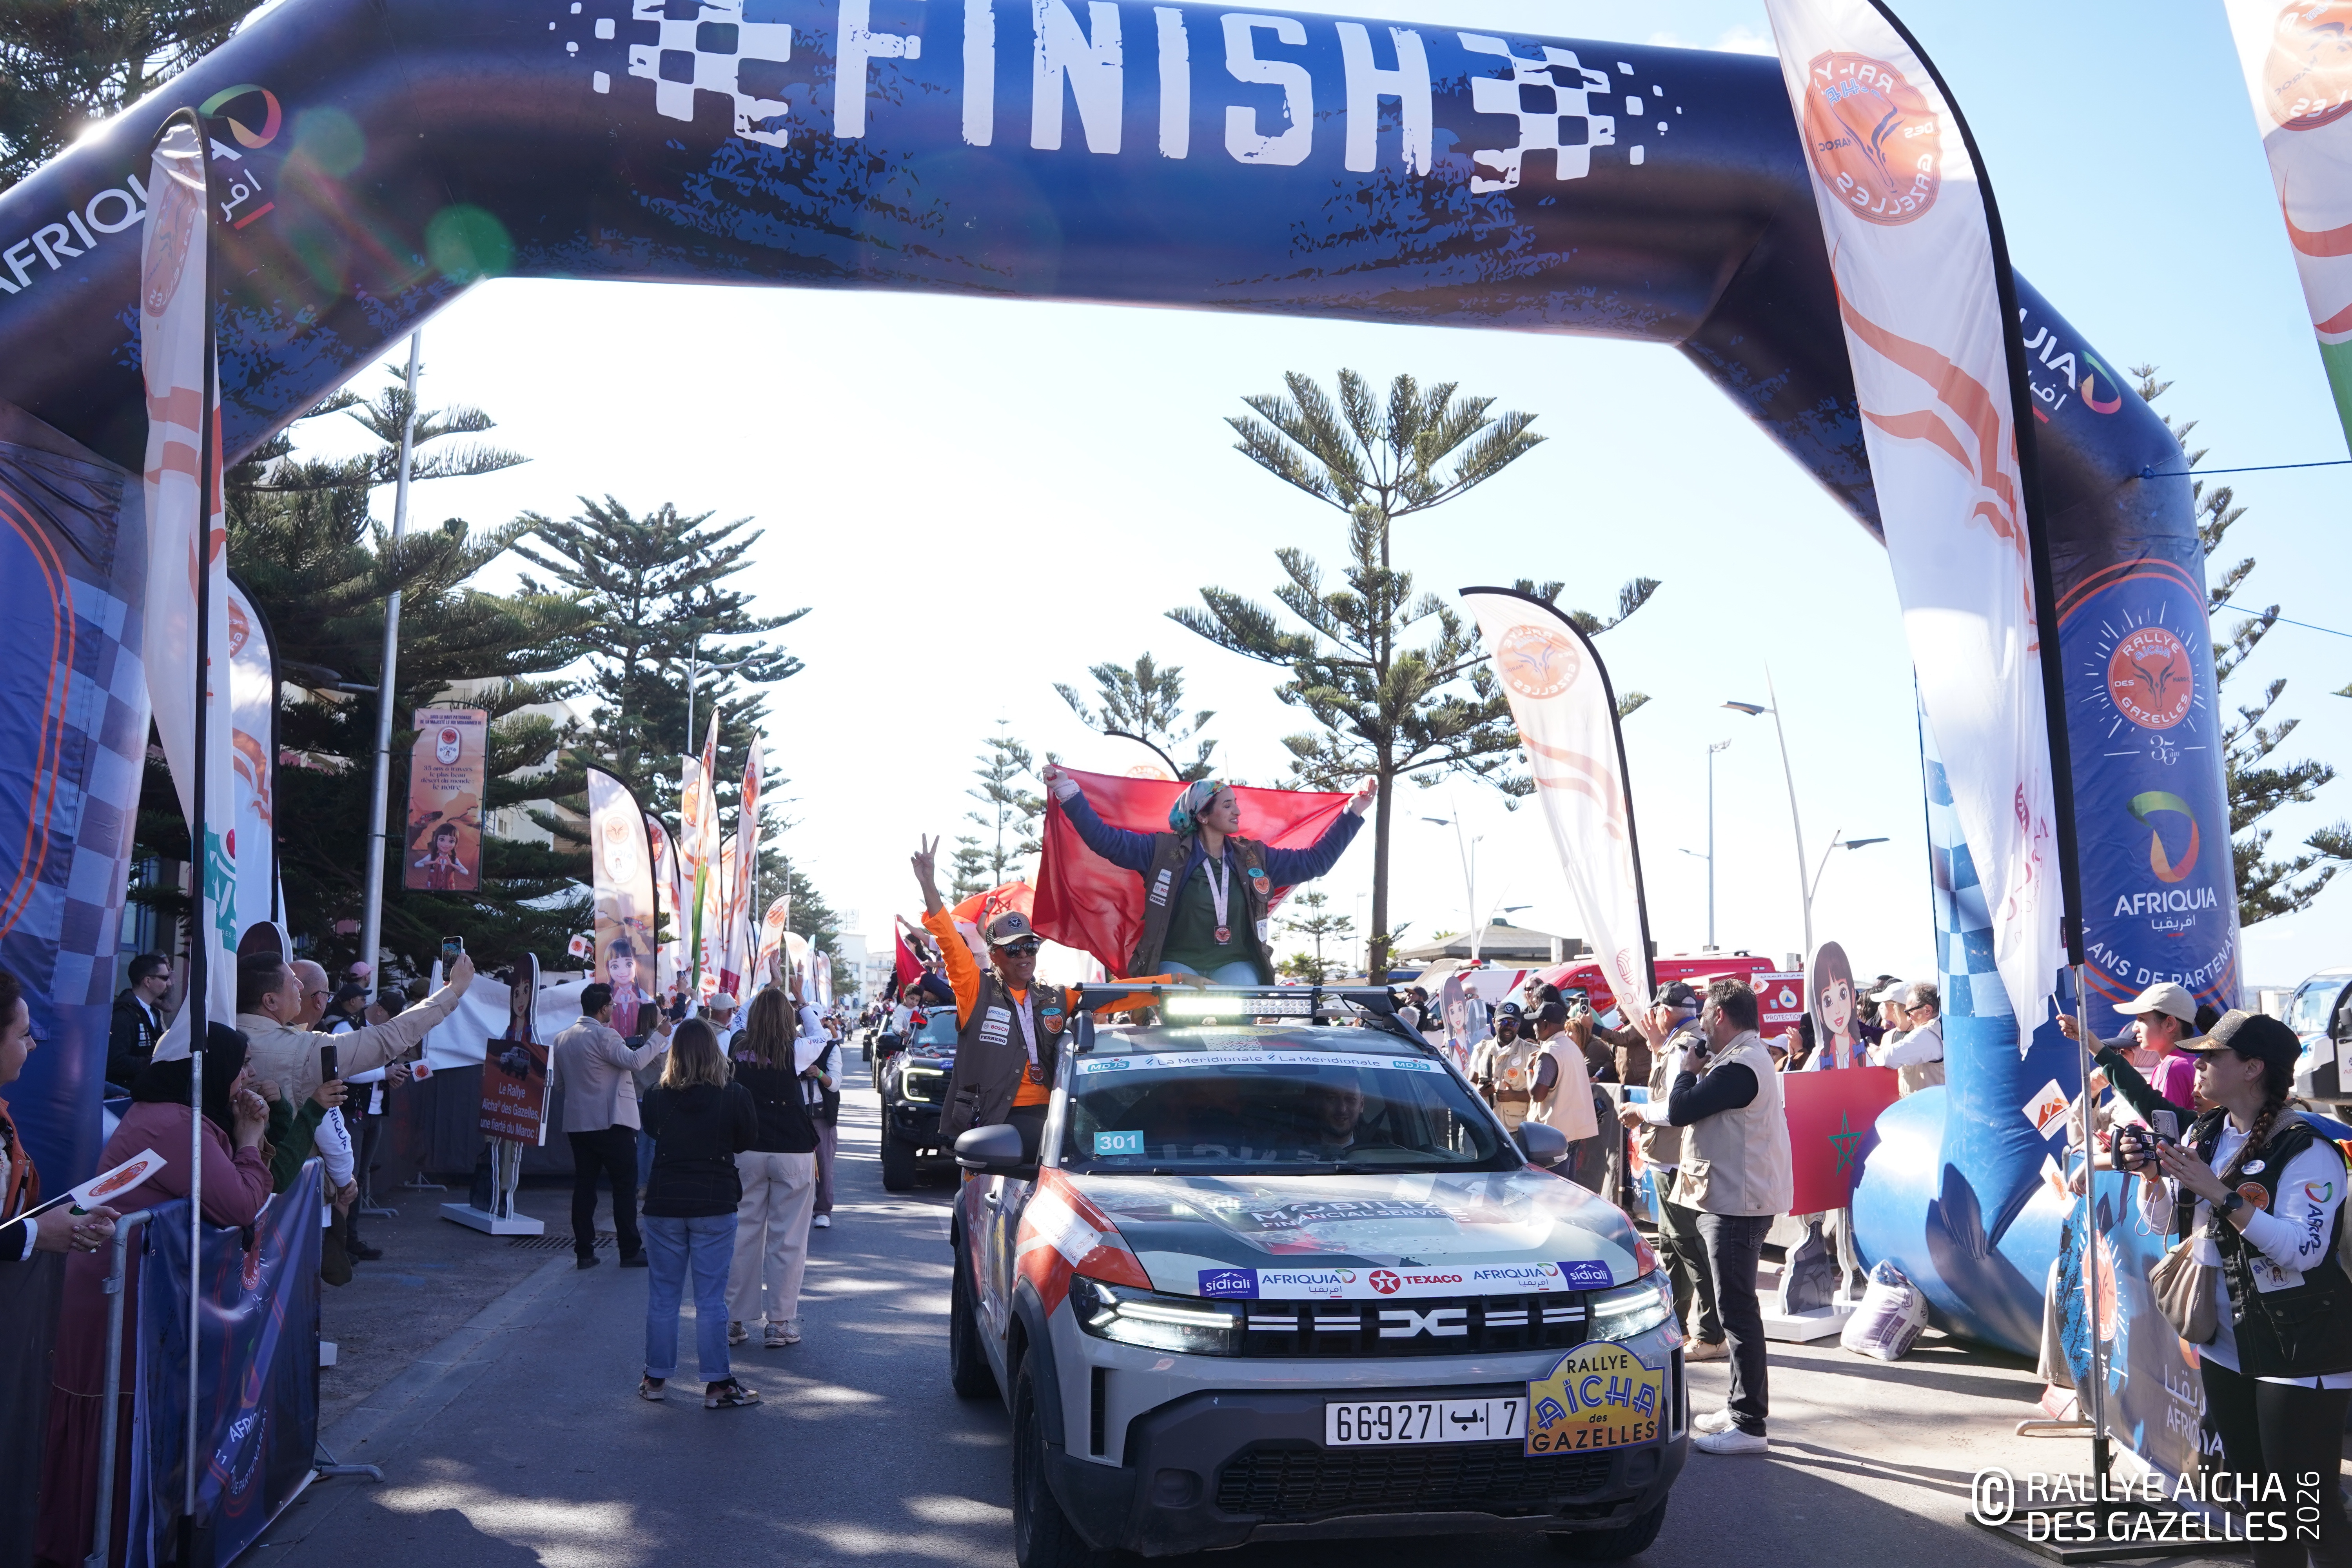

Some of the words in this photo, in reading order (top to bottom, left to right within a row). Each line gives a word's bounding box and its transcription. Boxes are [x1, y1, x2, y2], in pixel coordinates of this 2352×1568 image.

[834, 0, 1433, 176] FINISH
[2122, 633, 2180, 656] RALLYE
[2122, 693, 2188, 723] GAZELLES
[2114, 886, 2217, 917] AFRIQUIA
[2087, 942, 2131, 976] ANS
[1178, 1055, 1263, 1064] Méridionale
[1299, 1056, 1381, 1067] Méridionale
[498, 1082, 506, 1095] Le
[507, 1083, 526, 1100] Rallye
[501, 1101, 512, 1115] des
[480, 1118, 490, 1129] une
[491, 1118, 506, 1132] fierté
[506, 1121, 514, 1134] du
[515, 1123, 535, 1139] Maroc
[1100, 1134, 1136, 1150] 301
[1251, 1200, 1468, 1221] MOBILIZE
[1261, 1210, 1375, 1228] FINANCIAL
[1262, 1274, 1341, 1284] AFRIQUIA
[1403, 1274, 1463, 1284] TEXACO
[1474, 1268, 1542, 1280] AFRIQUIA
[1567, 1354, 1628, 1374] RALLYE
[1337, 1404, 1432, 1441] 66927
[1504, 1401, 1518, 1435] 7
[1589, 1412, 1608, 1424] des
[1532, 1420, 1656, 1452] GAZELLES
